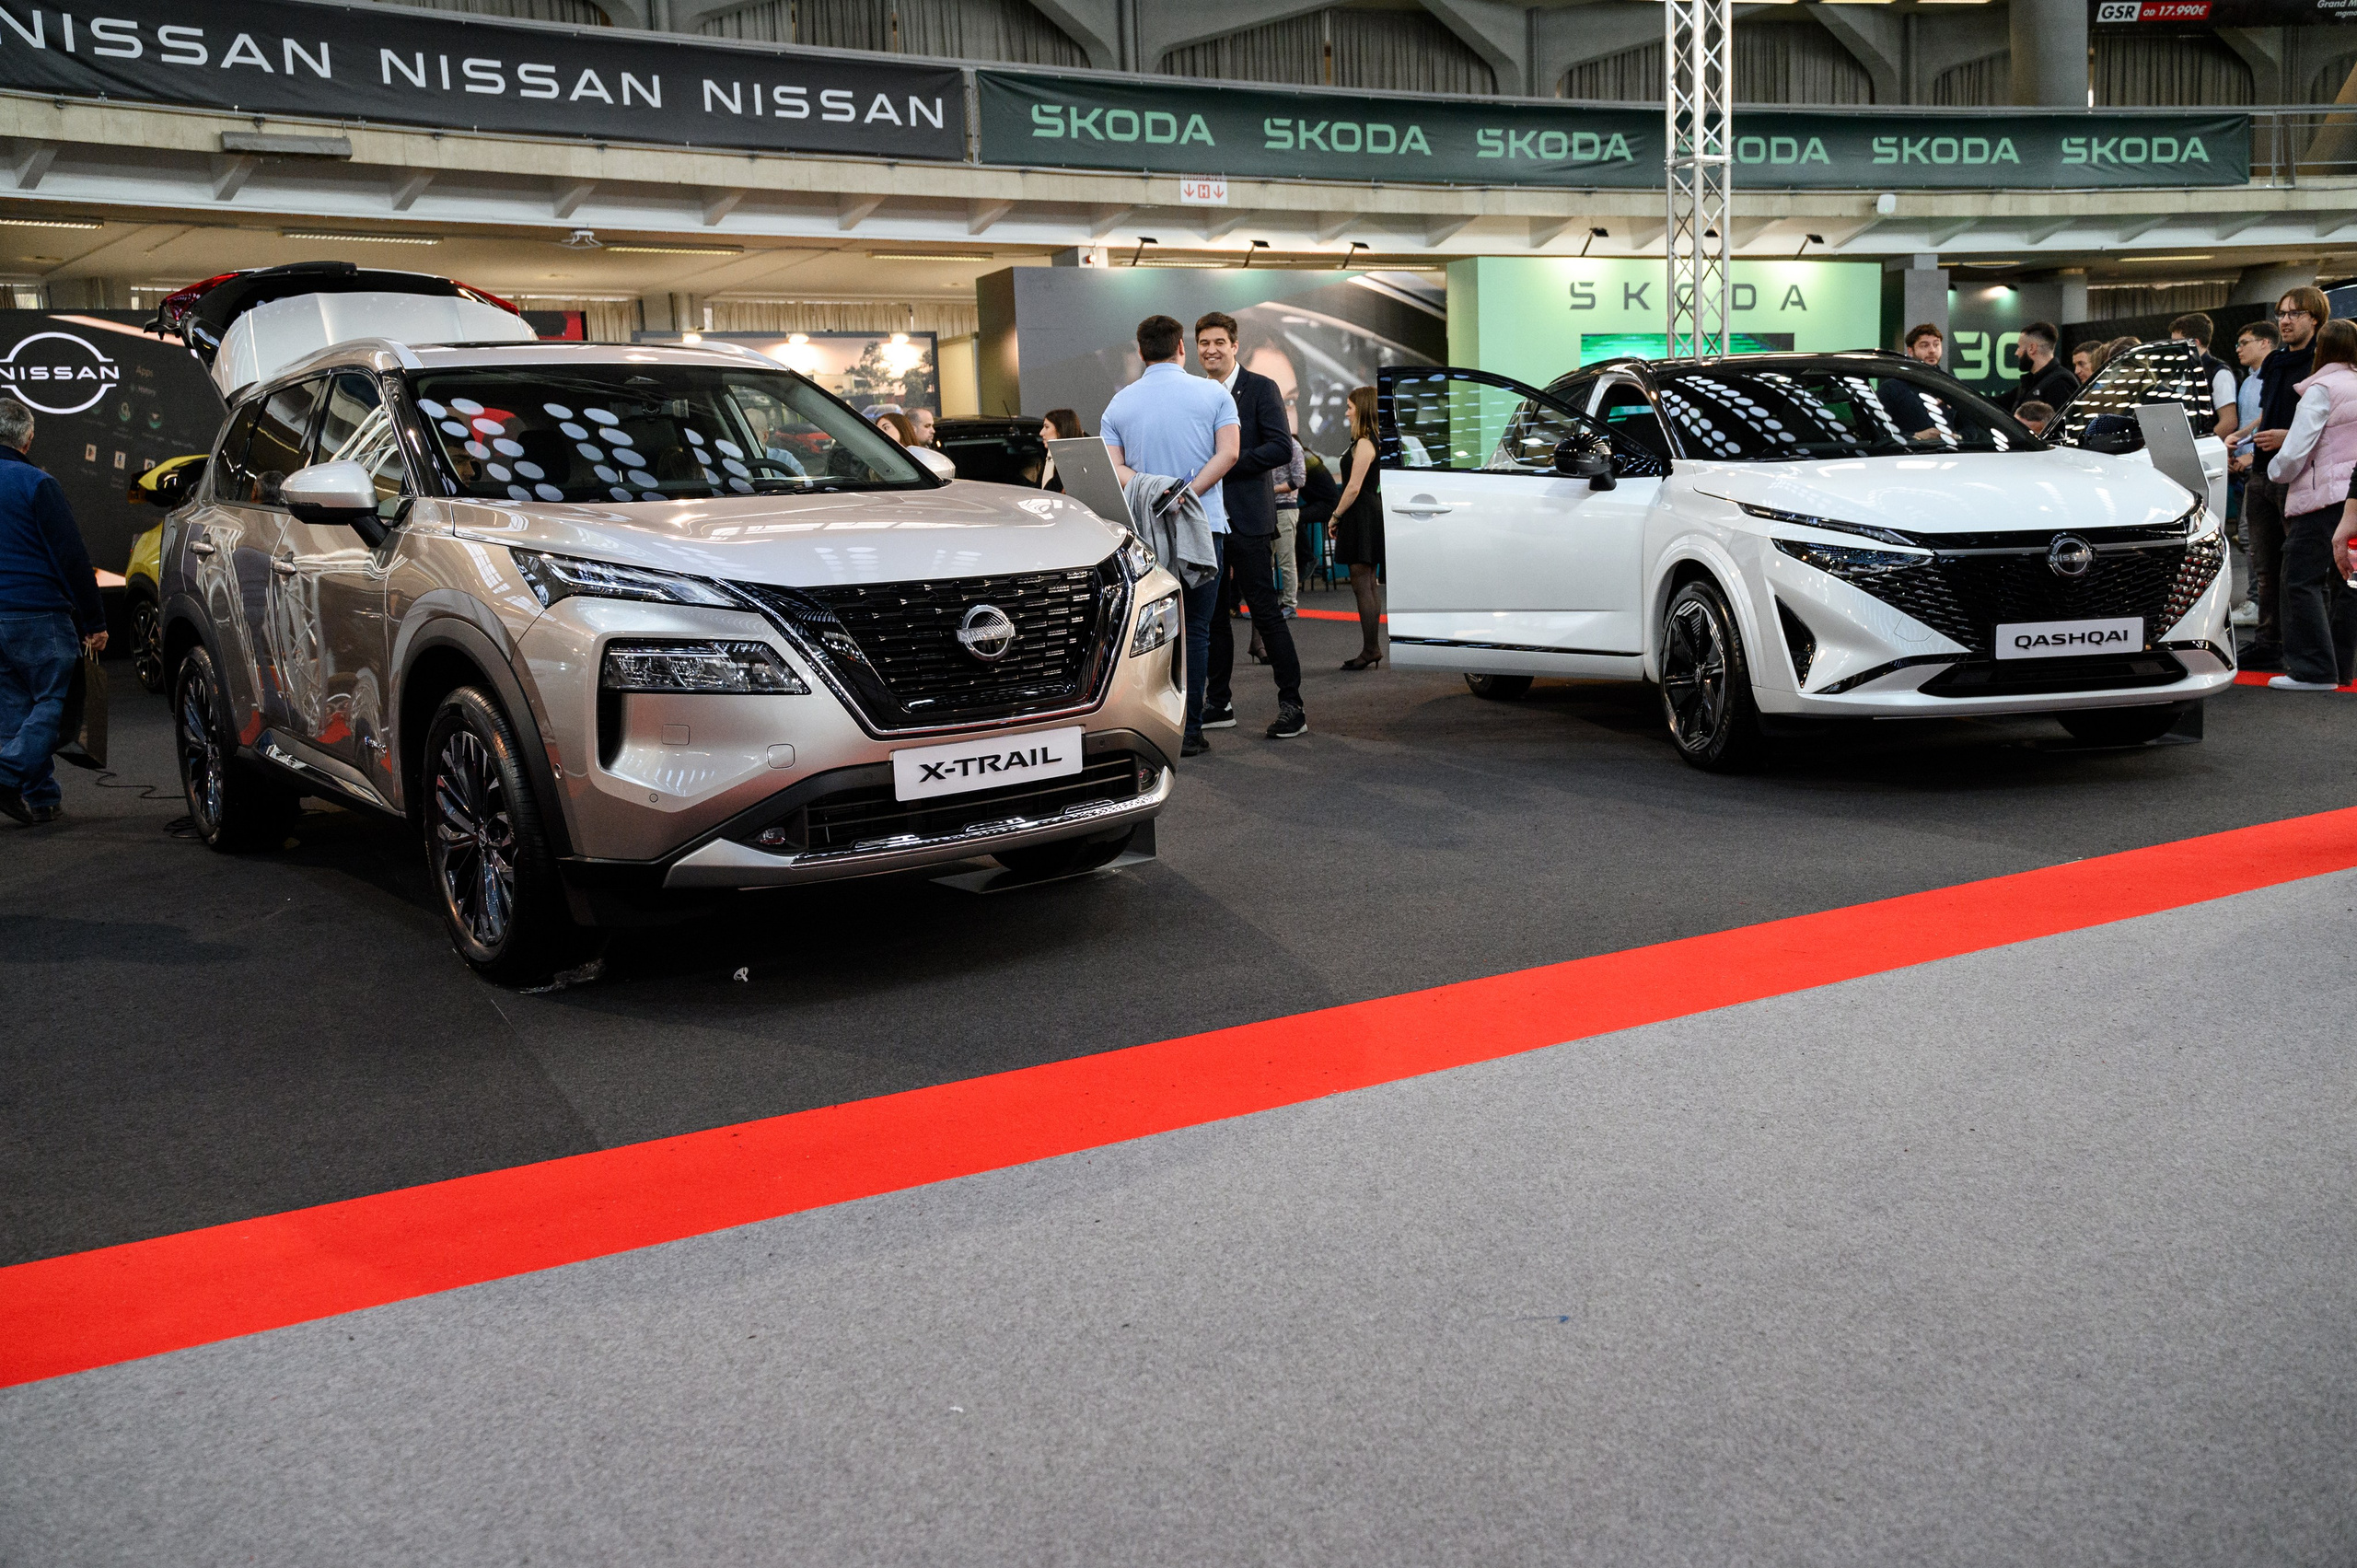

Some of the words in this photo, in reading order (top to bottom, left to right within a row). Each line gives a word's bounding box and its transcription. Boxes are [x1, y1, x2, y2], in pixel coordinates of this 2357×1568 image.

[2101, 5, 2136, 19] GSR
[2158, 5, 2208, 17] 17.990€
[2316, 0, 2347, 8] Grand
[0, 6, 331, 79] NISSAN
[380, 48, 662, 109] NISSAN
[702, 79, 944, 129] NISSAN
[0, 366, 120, 380] NISSAN
[2014, 629, 2129, 650] QASHQAI
[919, 746, 1062, 784] X-TRAIL
